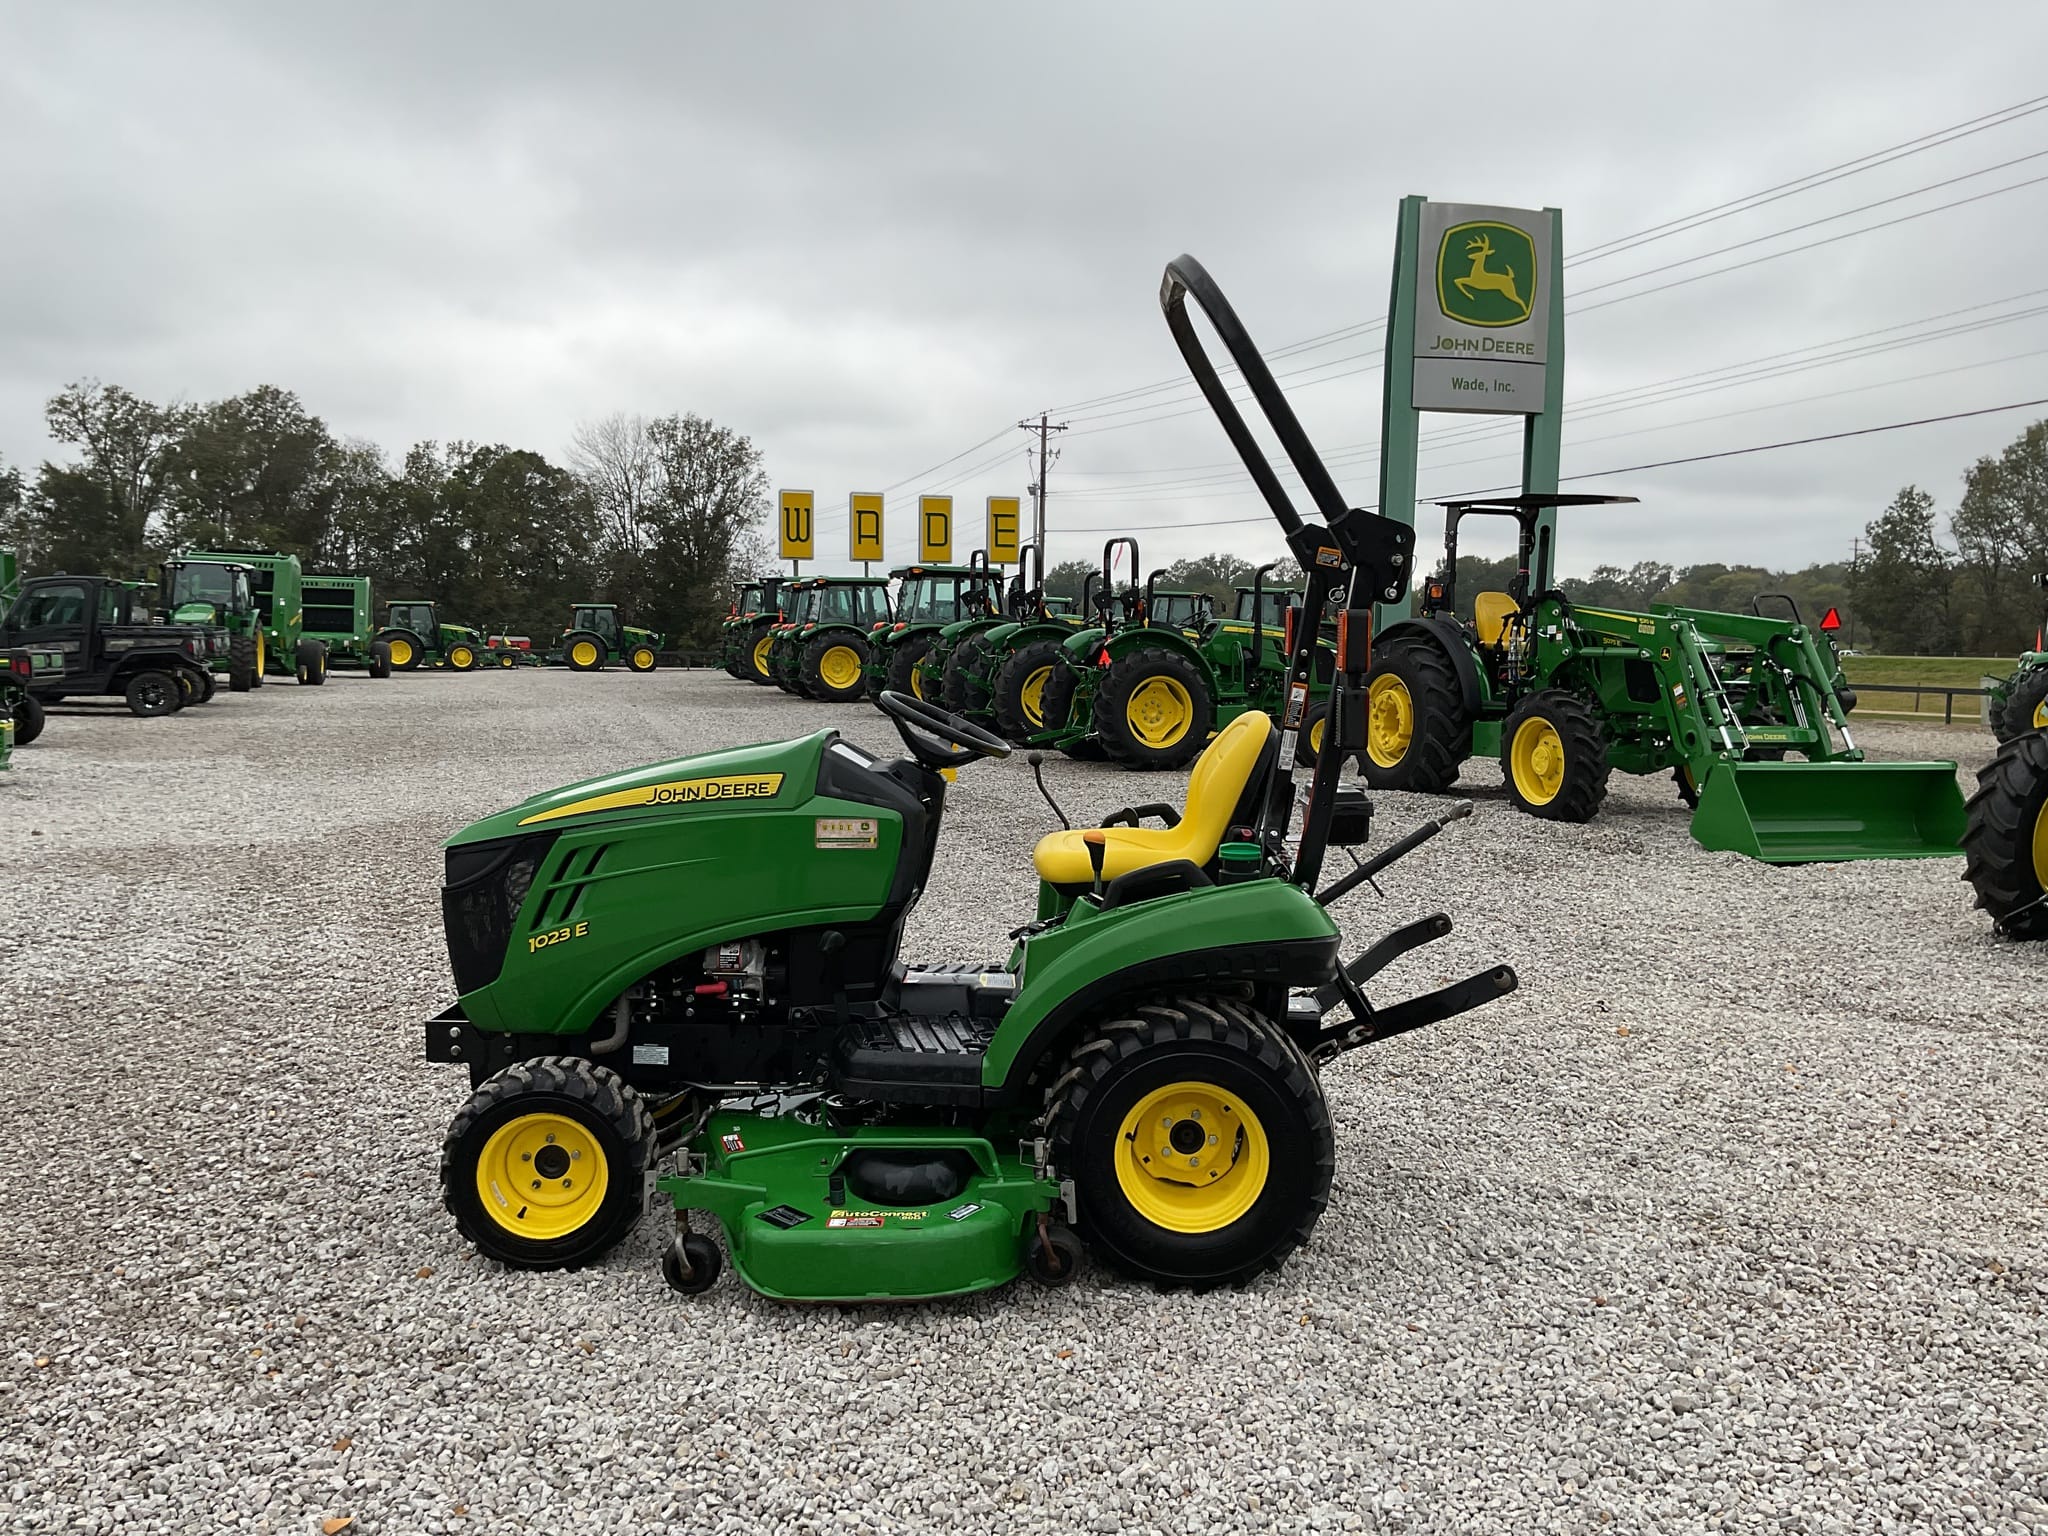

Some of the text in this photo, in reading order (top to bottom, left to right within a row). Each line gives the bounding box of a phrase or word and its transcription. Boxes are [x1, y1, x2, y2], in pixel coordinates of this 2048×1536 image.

[1430, 335, 1535, 355] JOHN DEERE
[1452, 377, 1516, 393] Wade, Inc.
[646, 782, 770, 803] JOHN DEERE
[528, 921, 589, 953] 1023 E
[830, 1209, 928, 1218] AutoConnect
